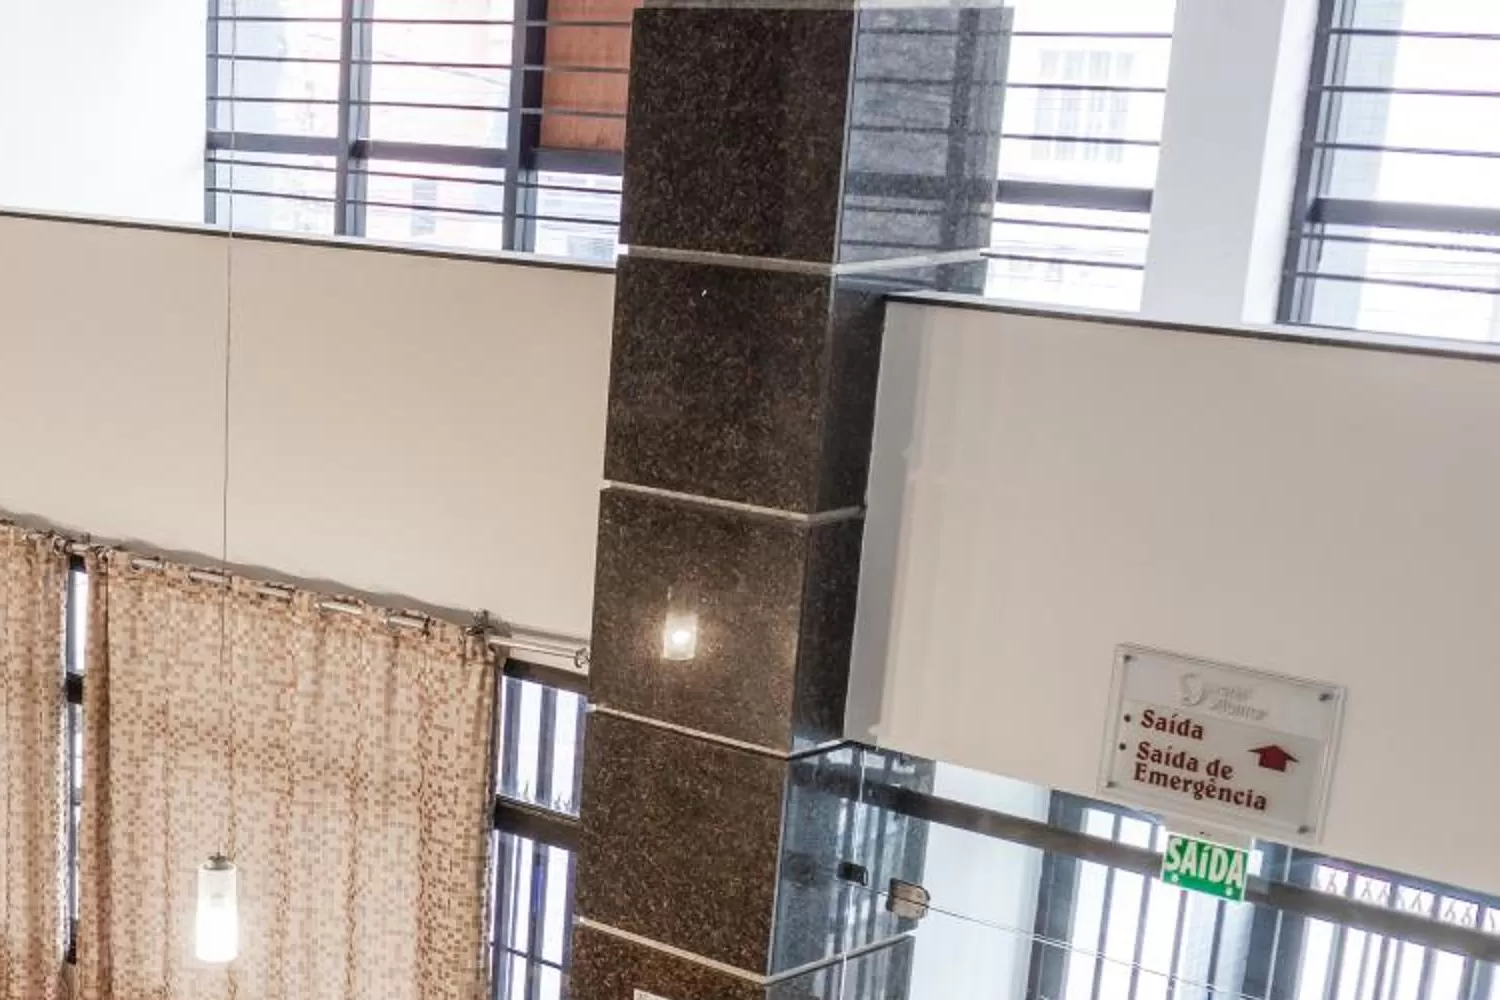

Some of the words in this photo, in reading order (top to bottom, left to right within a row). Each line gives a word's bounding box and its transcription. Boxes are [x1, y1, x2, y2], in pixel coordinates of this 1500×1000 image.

[1140, 708, 1205, 740] Saída
[1136, 741, 1199, 773] Saída
[1205, 757, 1234, 781] de
[1133, 762, 1269, 811] Emergência
